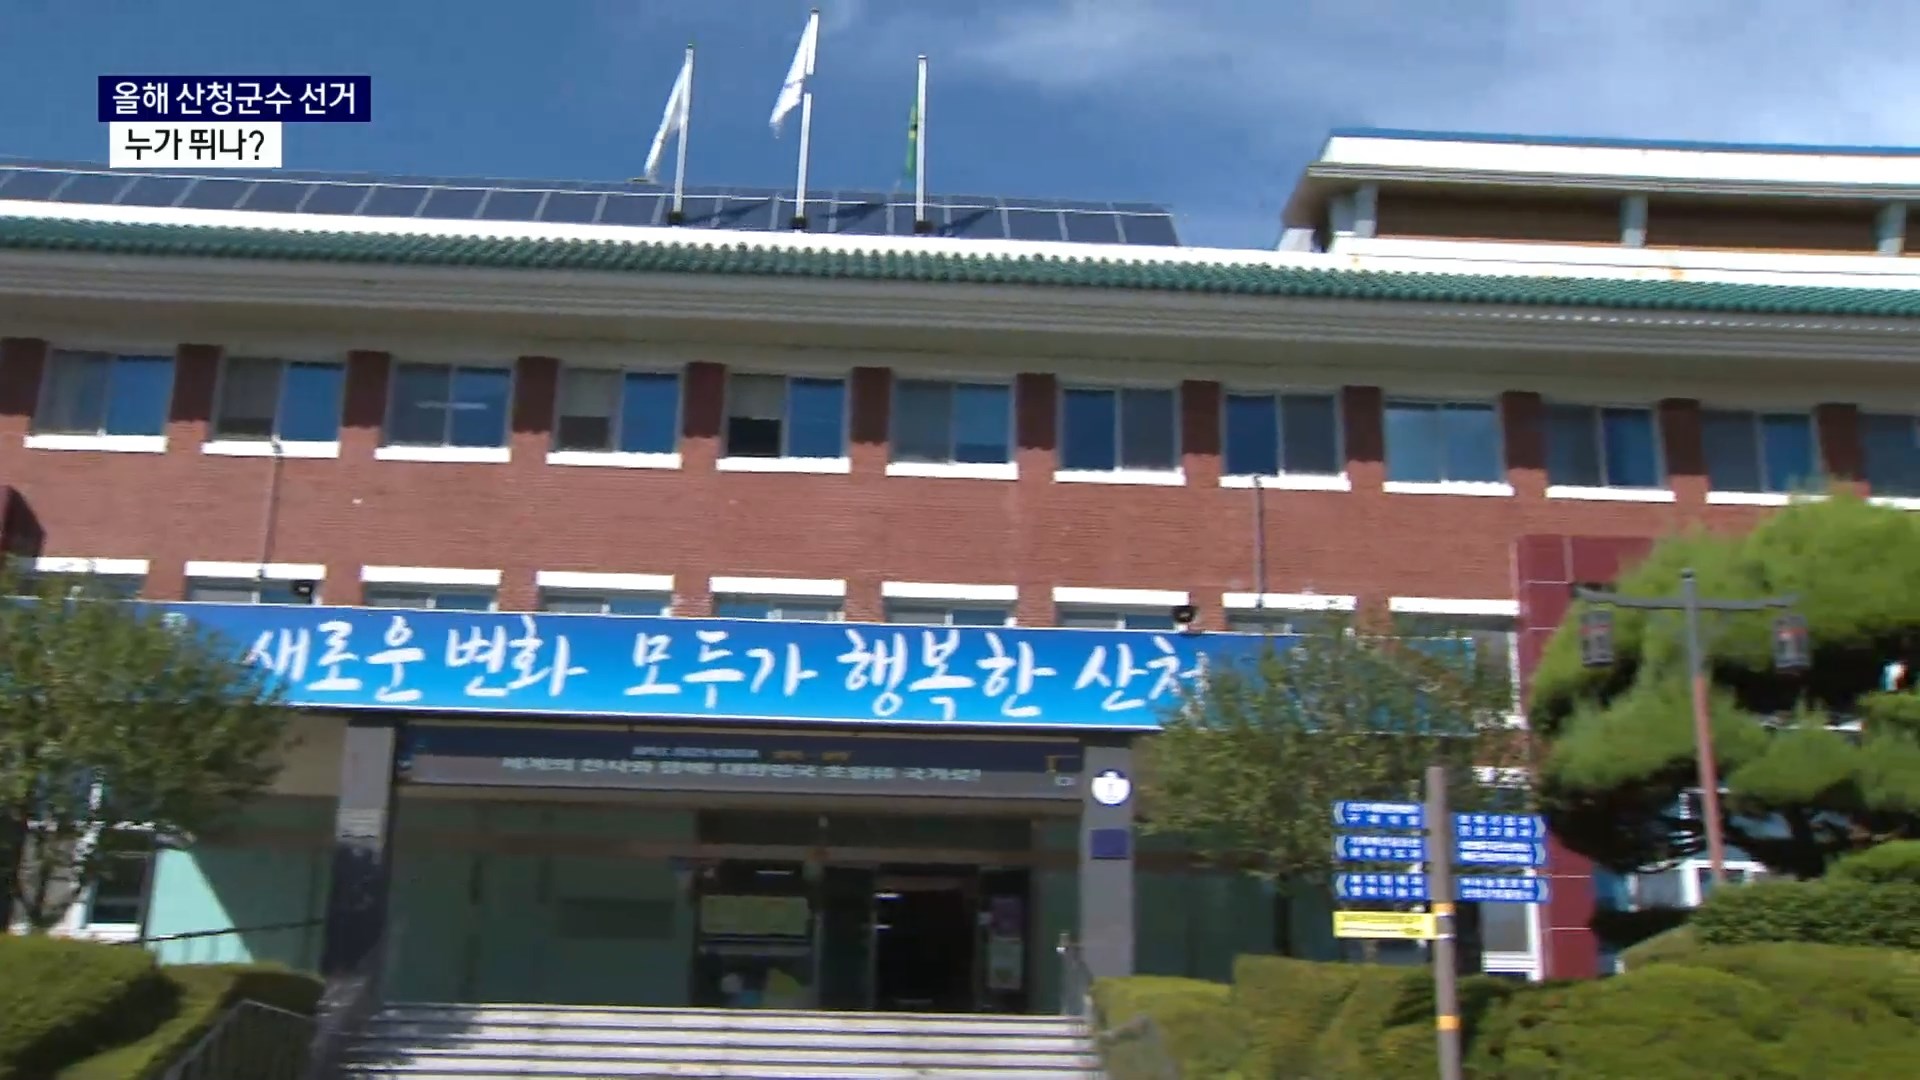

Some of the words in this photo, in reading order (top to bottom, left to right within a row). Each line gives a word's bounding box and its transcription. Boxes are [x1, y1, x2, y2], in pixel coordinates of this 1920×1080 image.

[244, 615, 425, 702] 새로운
[445, 614, 589, 698] 변화
[623, 629, 819, 711] 모두가
[836, 628, 1057, 721] 행복한
